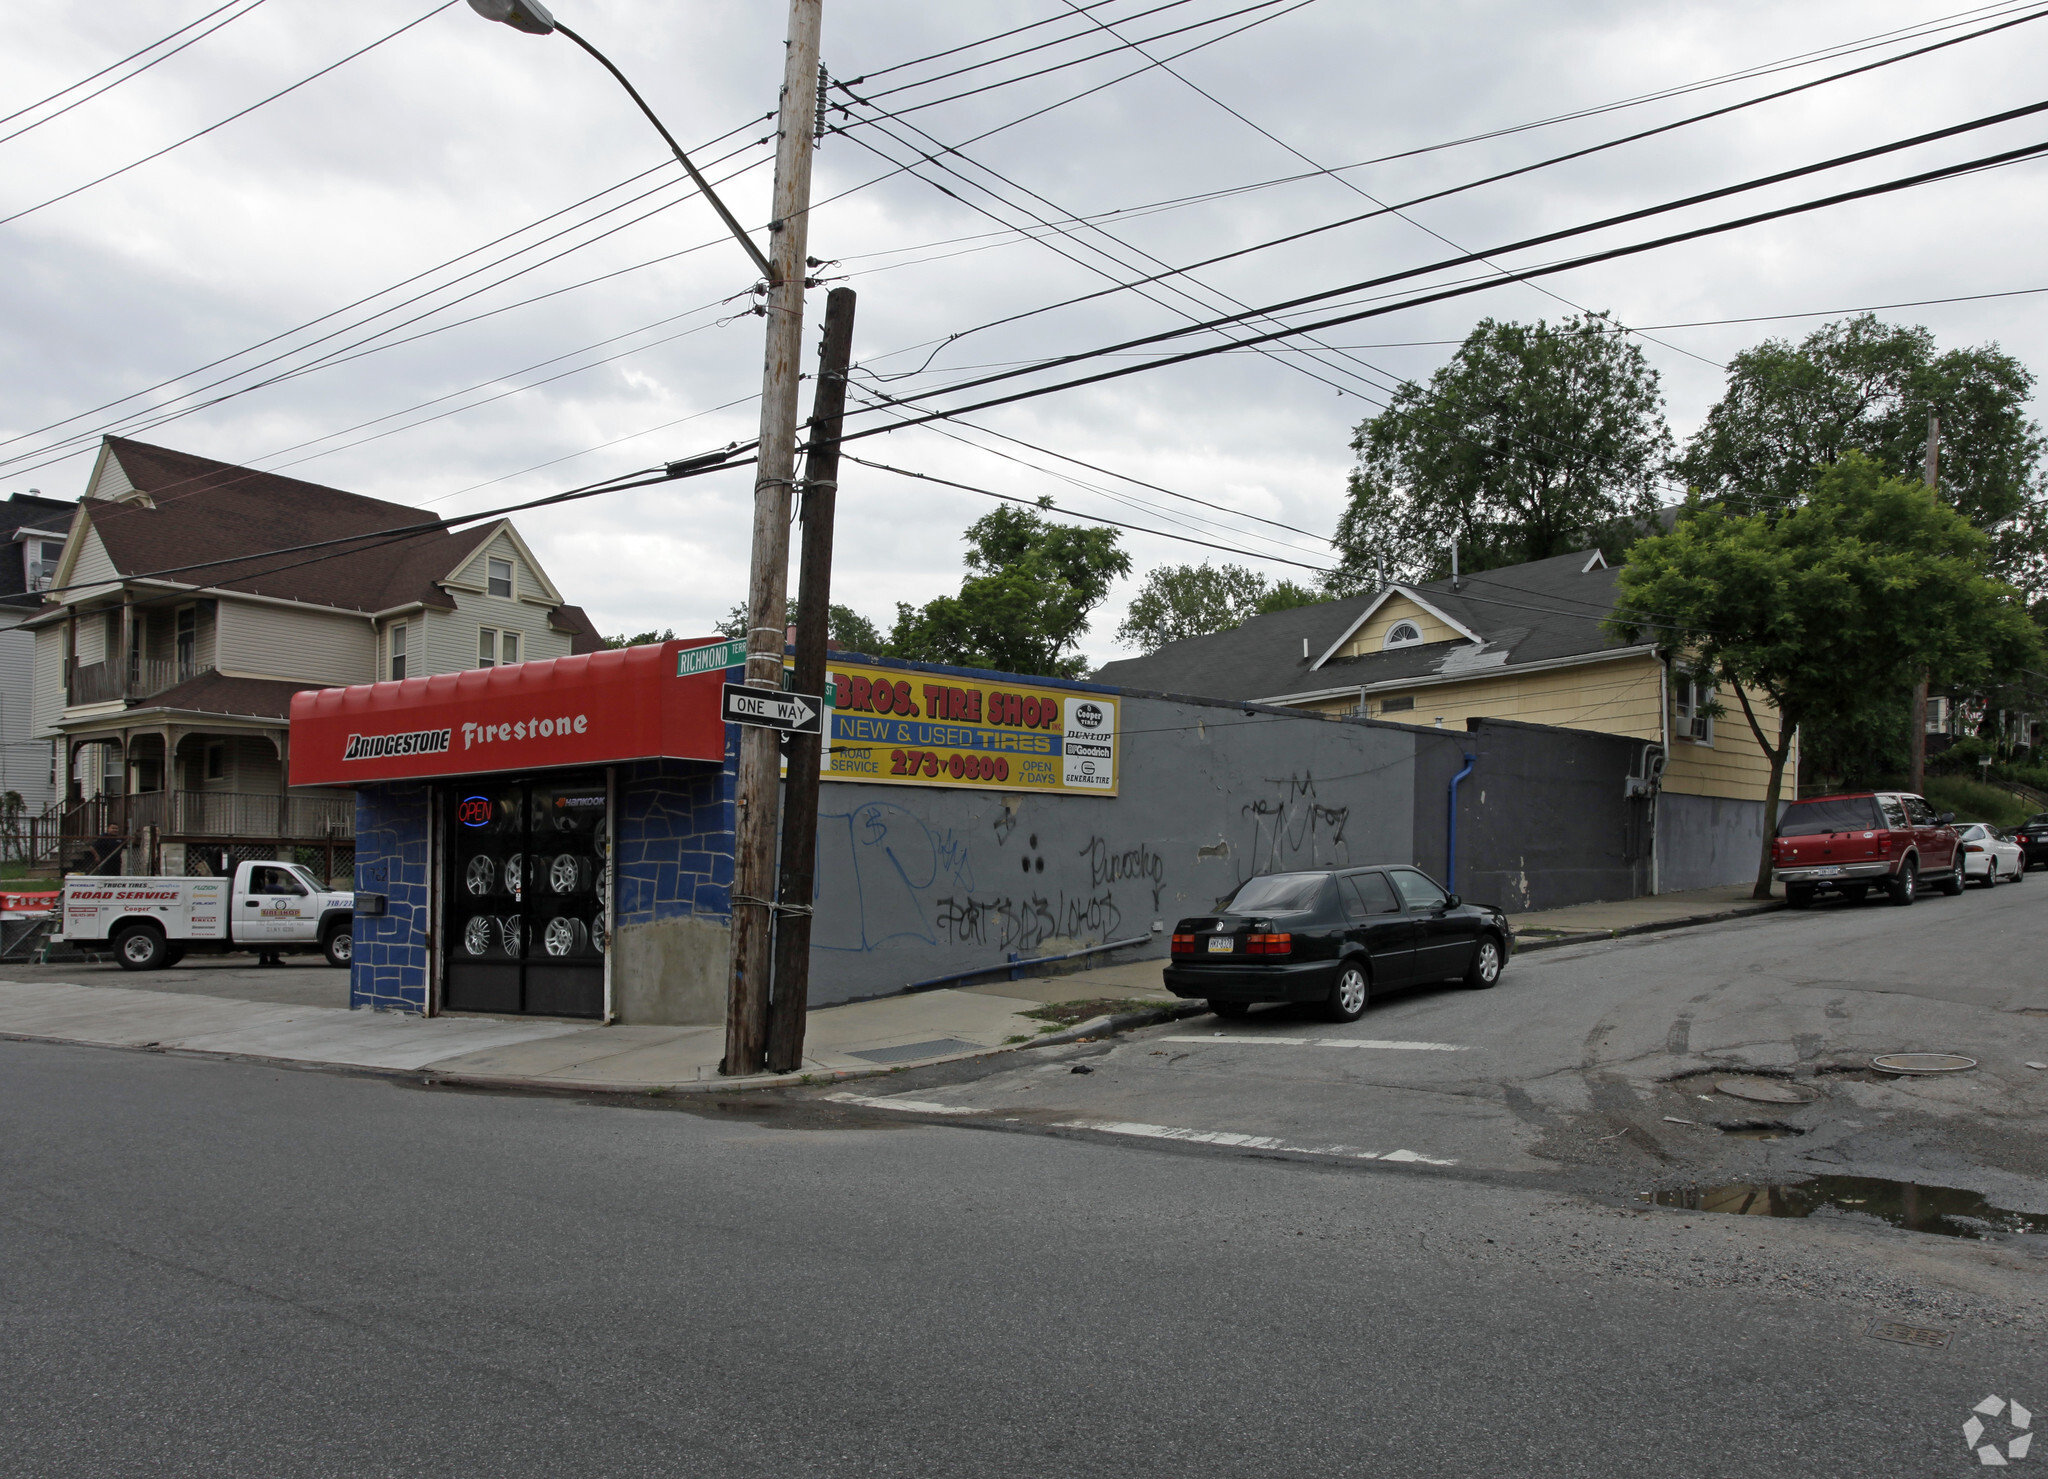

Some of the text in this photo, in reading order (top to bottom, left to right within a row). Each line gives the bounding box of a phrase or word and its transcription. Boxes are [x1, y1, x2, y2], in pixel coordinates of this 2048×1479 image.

[680, 645, 728, 673] RICHMOND
[826, 685, 833, 696] ST
[737, 697, 765, 715] ONE
[777, 703, 806, 720] WAY
[832, 673, 919, 717] BROS.
[923, 684, 981, 723] TIRE
[987, 691, 1058, 730] SHOP
[1077, 708, 1102, 721] Cooper
[345, 714, 588, 760] BRIDGESTONE Firestone
[840, 718, 1050, 753] NEW & USED TIRES
[1067, 730, 1111, 742] DUNLOP
[840, 748, 872, 760] ROAD
[1067, 744, 1110, 758] BFGoodrich
[831, 759, 879, 773] SERVICE
[1022, 760, 1052, 772] OPEN
[1018, 771, 1056, 785] 7 DAYS
[1066, 774, 1110, 785] GENERAL TIRE
[458, 801, 492, 822] OPEN
[71, 891, 180, 900] ROAD SERVICE
